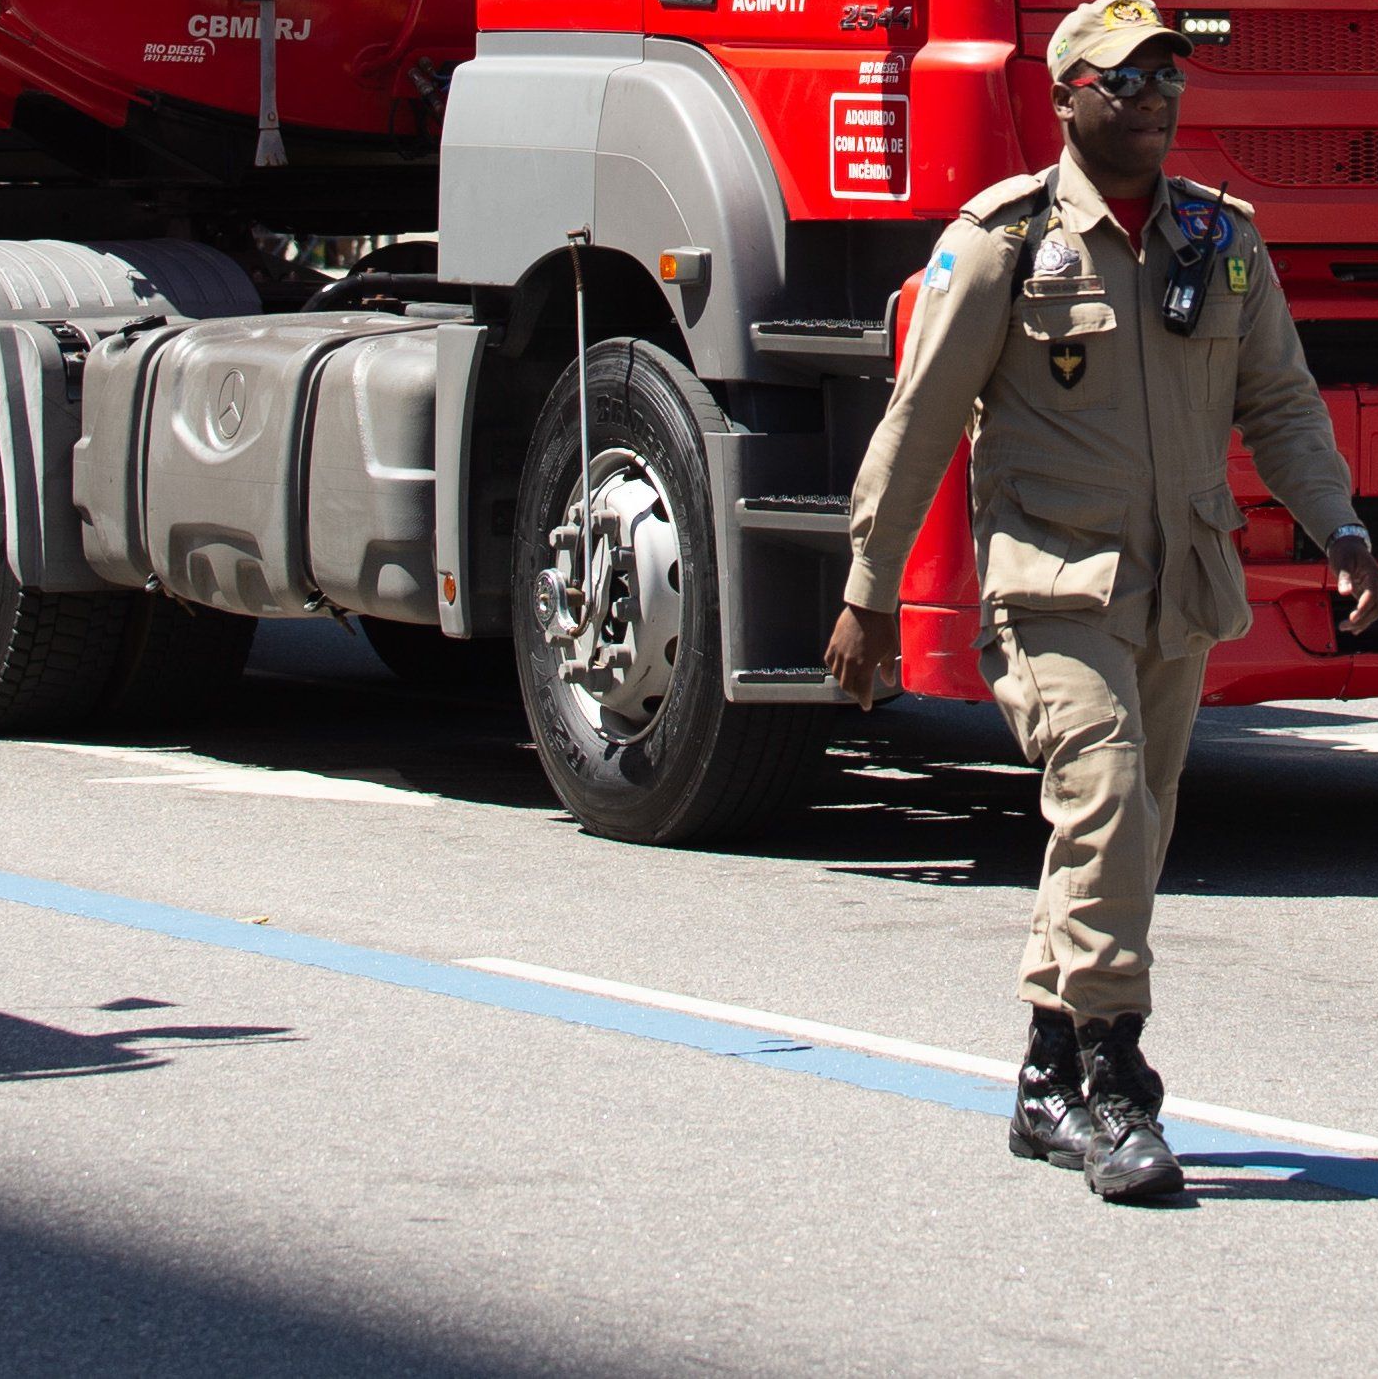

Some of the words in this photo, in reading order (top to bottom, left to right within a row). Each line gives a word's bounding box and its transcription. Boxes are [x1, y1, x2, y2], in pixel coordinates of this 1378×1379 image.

[838, 3, 913, 32] 2544
[144, 43, 166, 54] RIO
[167, 44, 207, 56] DIESEL
[844, 109, 896, 126] ADQUIRIDO
[835, 135, 856, 153] COM
[856, 136, 865, 153] A
[865, 136, 889, 153] TAXA
[890, 137, 904, 153] DE
[848, 158, 892, 180] INCÊNDIO
